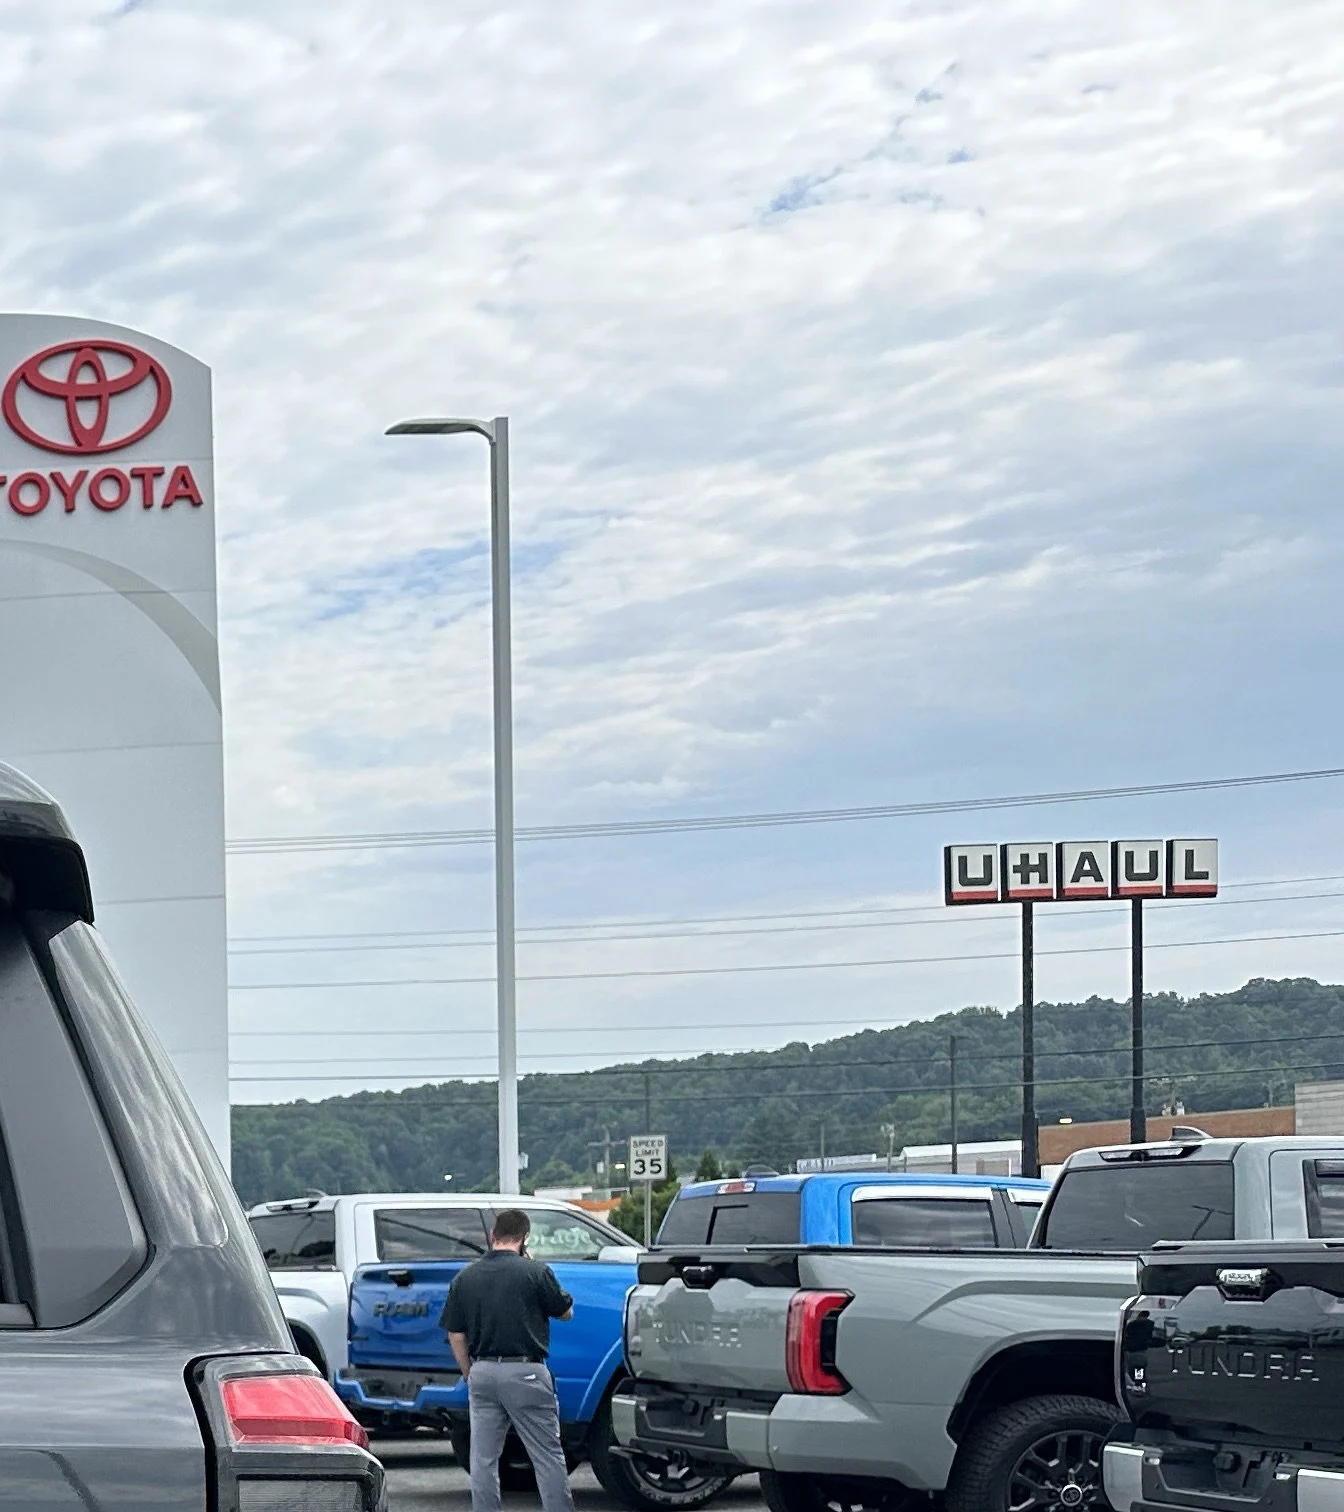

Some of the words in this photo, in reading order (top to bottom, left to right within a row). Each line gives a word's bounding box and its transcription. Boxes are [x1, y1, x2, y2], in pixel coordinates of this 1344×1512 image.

[632, 1140, 664, 1149] SPEED
[635, 1149, 659, 1157] LIMIT
[633, 1158, 662, 1175] 35
[373, 1301, 429, 1318] RAM
[1166, 1347, 1320, 1382] TUNDRA
